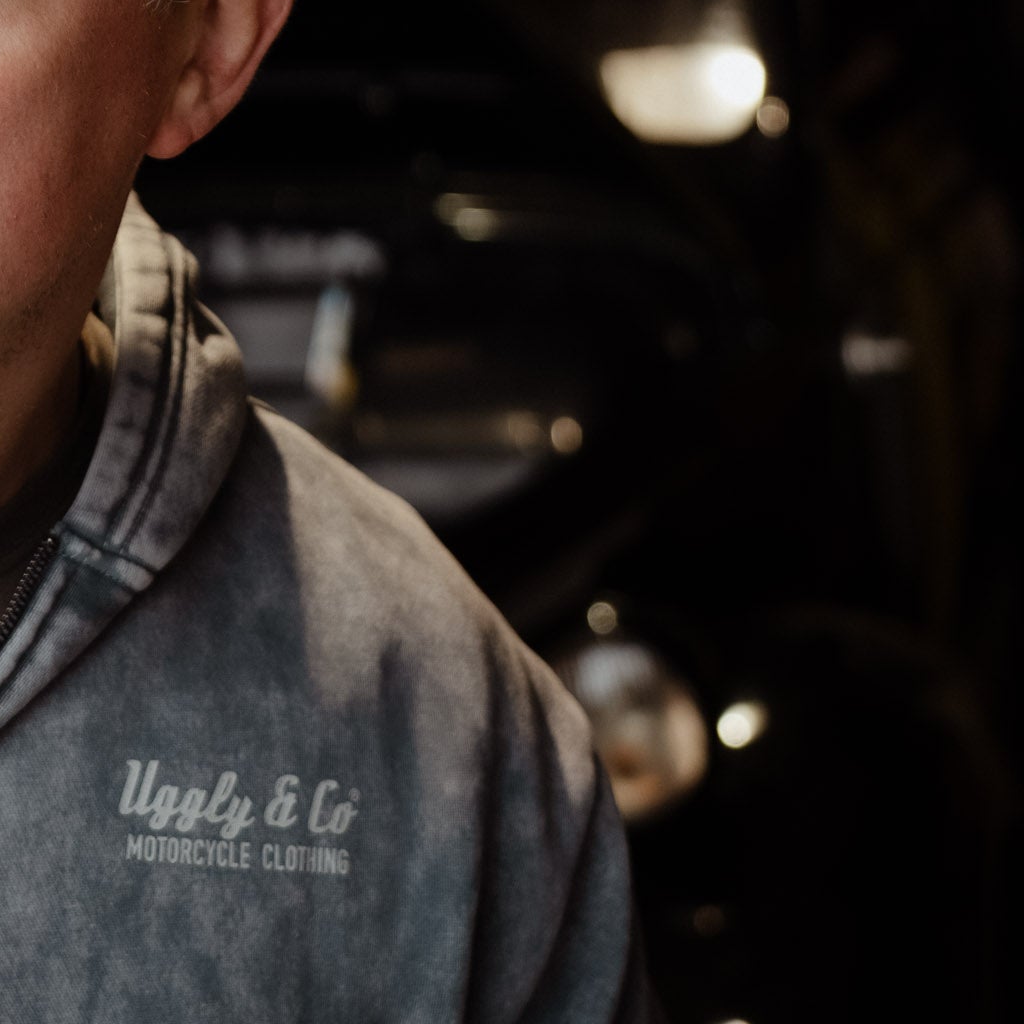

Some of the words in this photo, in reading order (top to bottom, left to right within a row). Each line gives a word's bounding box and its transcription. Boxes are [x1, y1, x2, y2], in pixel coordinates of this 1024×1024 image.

[118, 759, 256, 839] Uggly
[264, 774, 300, 827] &
[126, 833, 251, 869] MOTORCYCLE
[262, 843, 350, 874] CLOTHING
